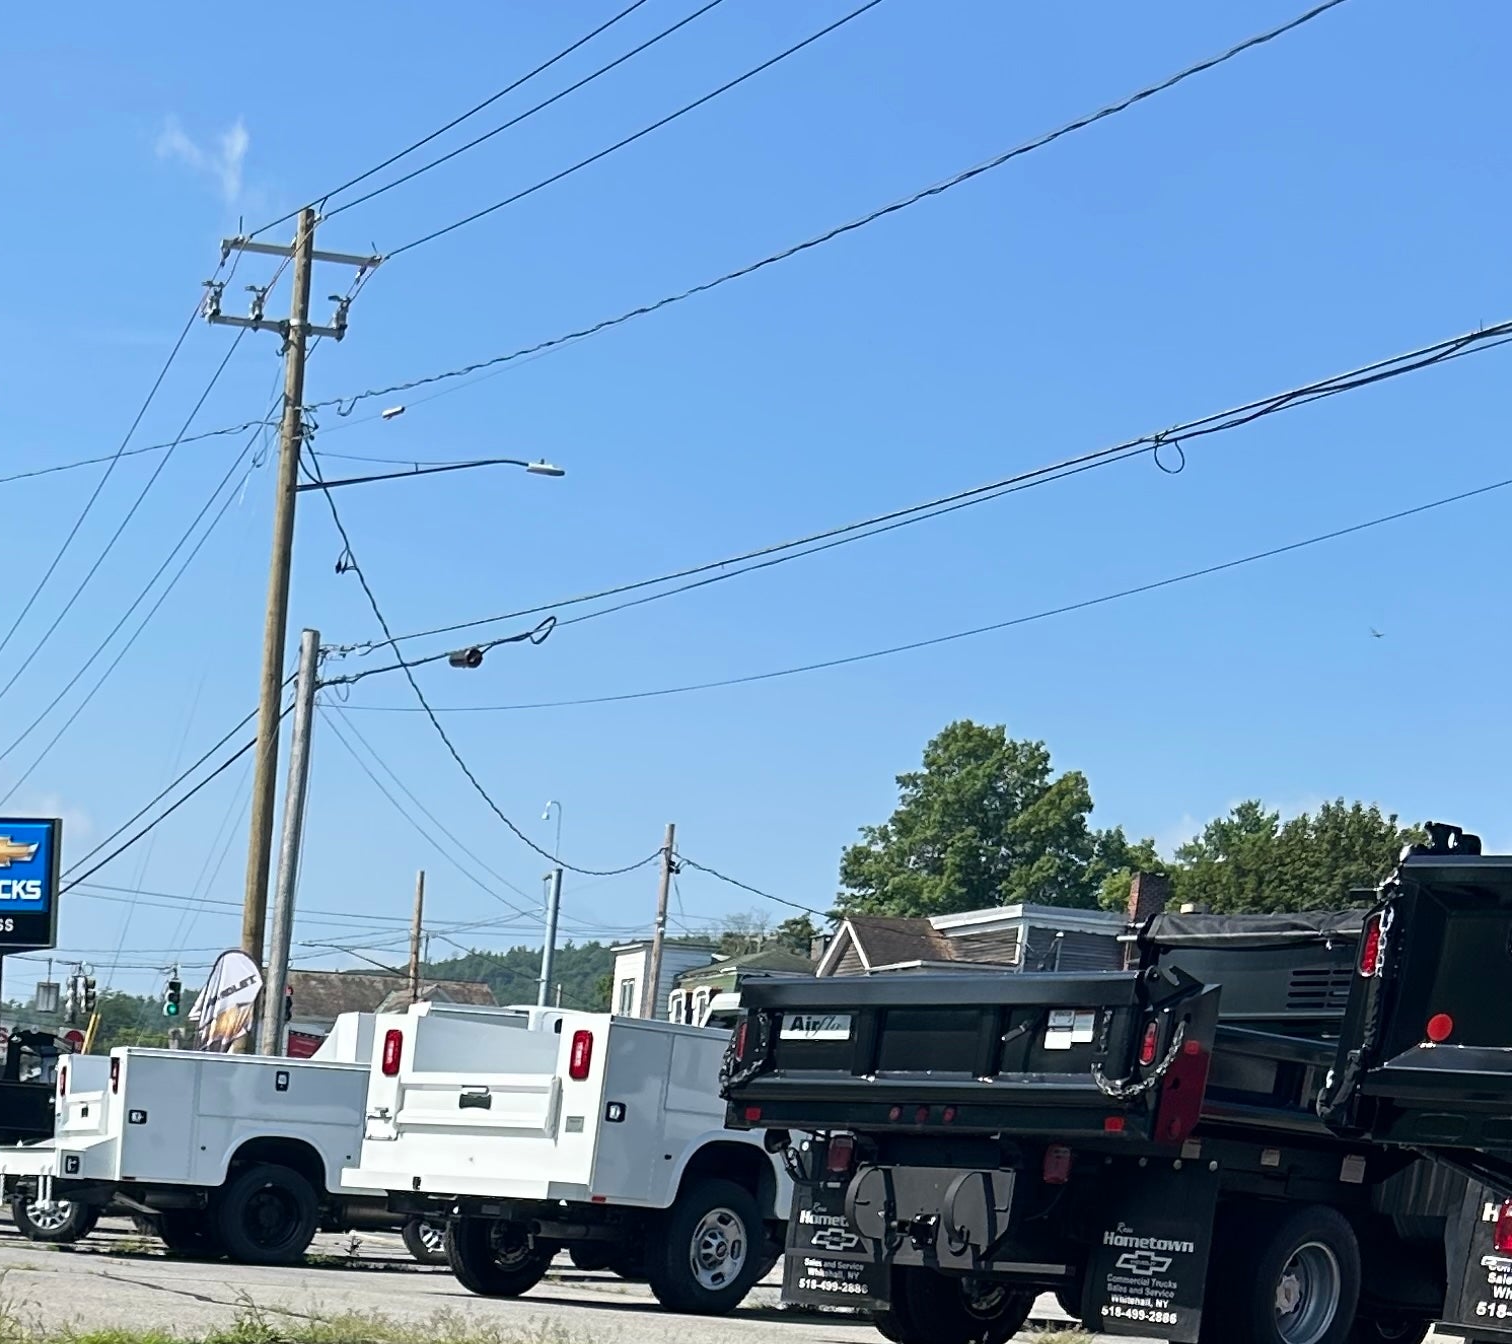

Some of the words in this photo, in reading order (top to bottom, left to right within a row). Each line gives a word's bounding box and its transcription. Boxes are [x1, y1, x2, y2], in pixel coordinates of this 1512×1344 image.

[799, 1210, 850, 1227] Homet
[1103, 1230, 1195, 1252] Hometown
[837, 1261, 864, 1271] Service
[847, 1271, 860, 1280] NY
[1107, 1273, 1150, 1286] Commercial
[1151, 1278, 1178, 1289] Trucks
[1487, 1272, 1512, 1286] Sale
[1107, 1283, 1128, 1294] Sales
[1128, 1286, 1144, 1295] and
[1144, 1287, 1175, 1299] Service
[1155, 1299, 1170, 1309] NY
[1100, 1305, 1178, 1325] 518-499-2886
